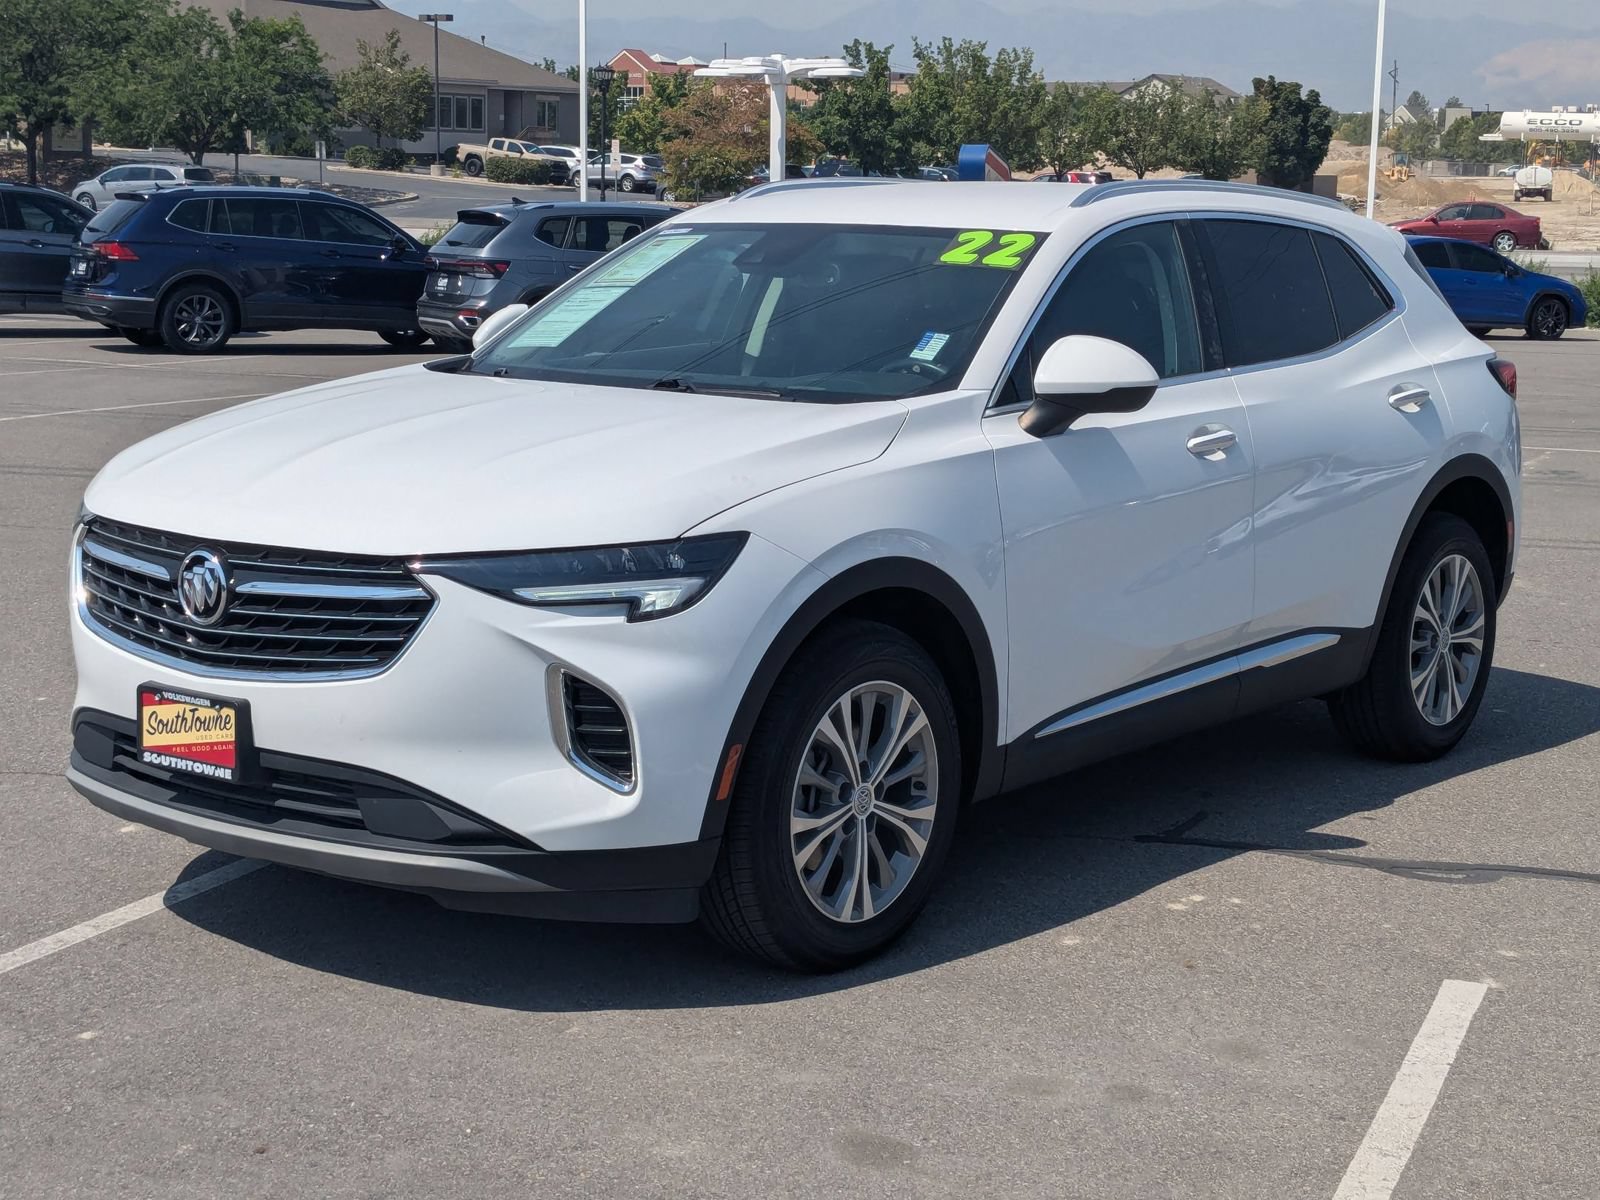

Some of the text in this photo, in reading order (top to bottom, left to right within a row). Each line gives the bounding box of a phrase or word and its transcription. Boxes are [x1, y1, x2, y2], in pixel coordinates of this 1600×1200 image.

[1527, 118, 1583, 126] ECCO
[940, 230, 1036, 269] 22
[163, 692, 210, 706] VOLKSWAGEN
[146, 707, 233, 735] SouthTowne
[143, 752, 232, 780] SOUTHTOWNE
